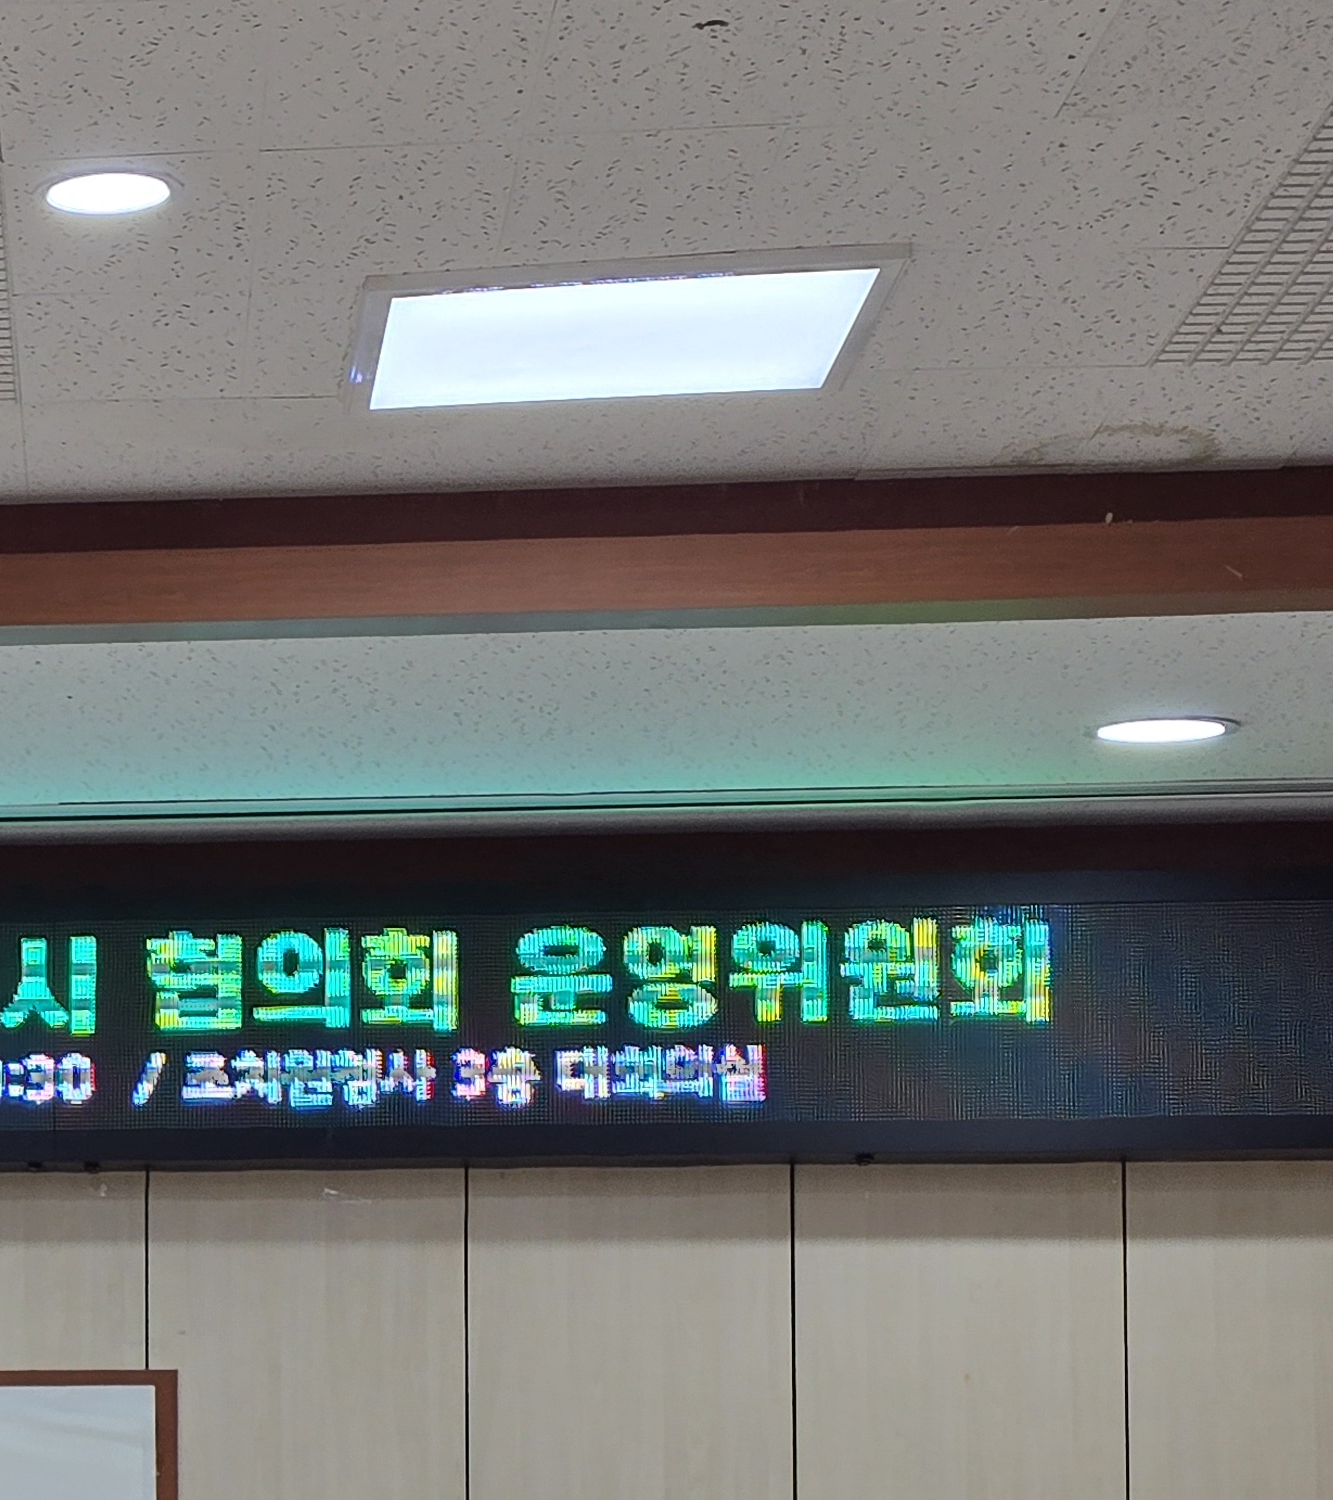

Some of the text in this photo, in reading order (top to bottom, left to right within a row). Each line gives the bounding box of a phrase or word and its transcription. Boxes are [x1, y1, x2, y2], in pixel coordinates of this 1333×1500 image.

[146, 927, 459, 1032] 협의회
[510, 917, 1052, 1028] 운영위원회
[453, 1046, 541, 1109] 3층
[554, 1044, 768, 1102] 대회의실
